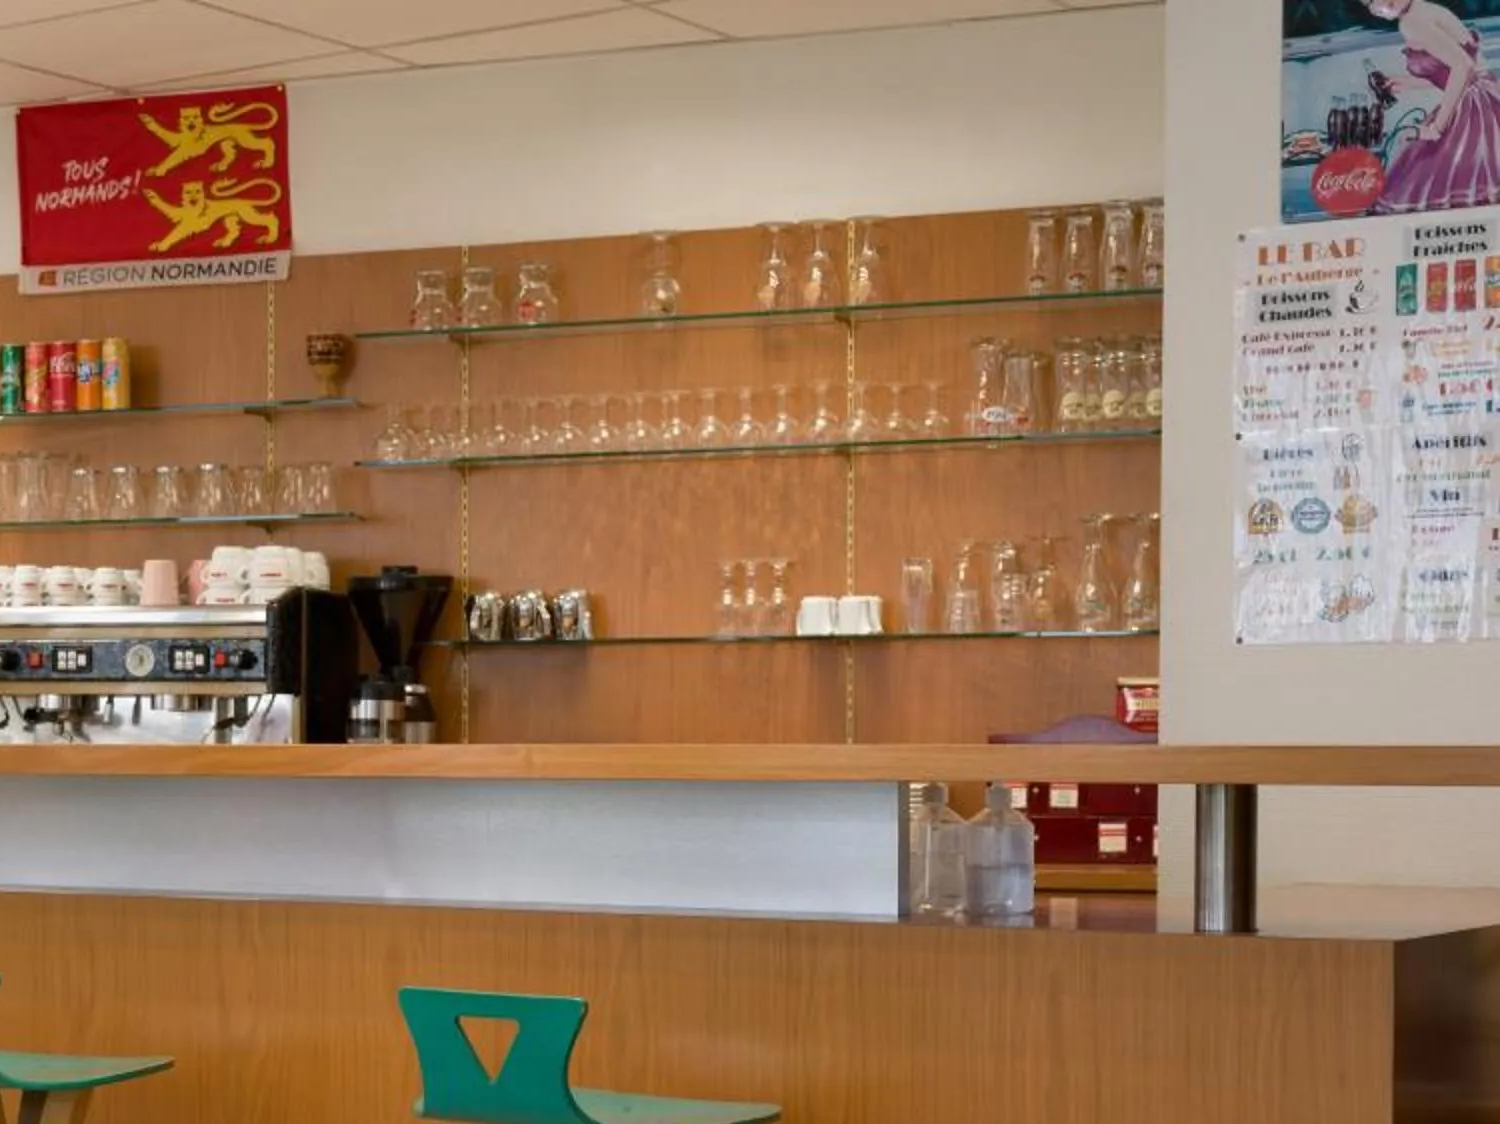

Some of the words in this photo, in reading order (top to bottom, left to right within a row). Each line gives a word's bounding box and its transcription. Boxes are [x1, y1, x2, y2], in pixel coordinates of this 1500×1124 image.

[62, 156, 109, 184] TOUS
[1302, 237, 1366, 262] BAR
[152, 258, 277, 281] NORMANDIE
